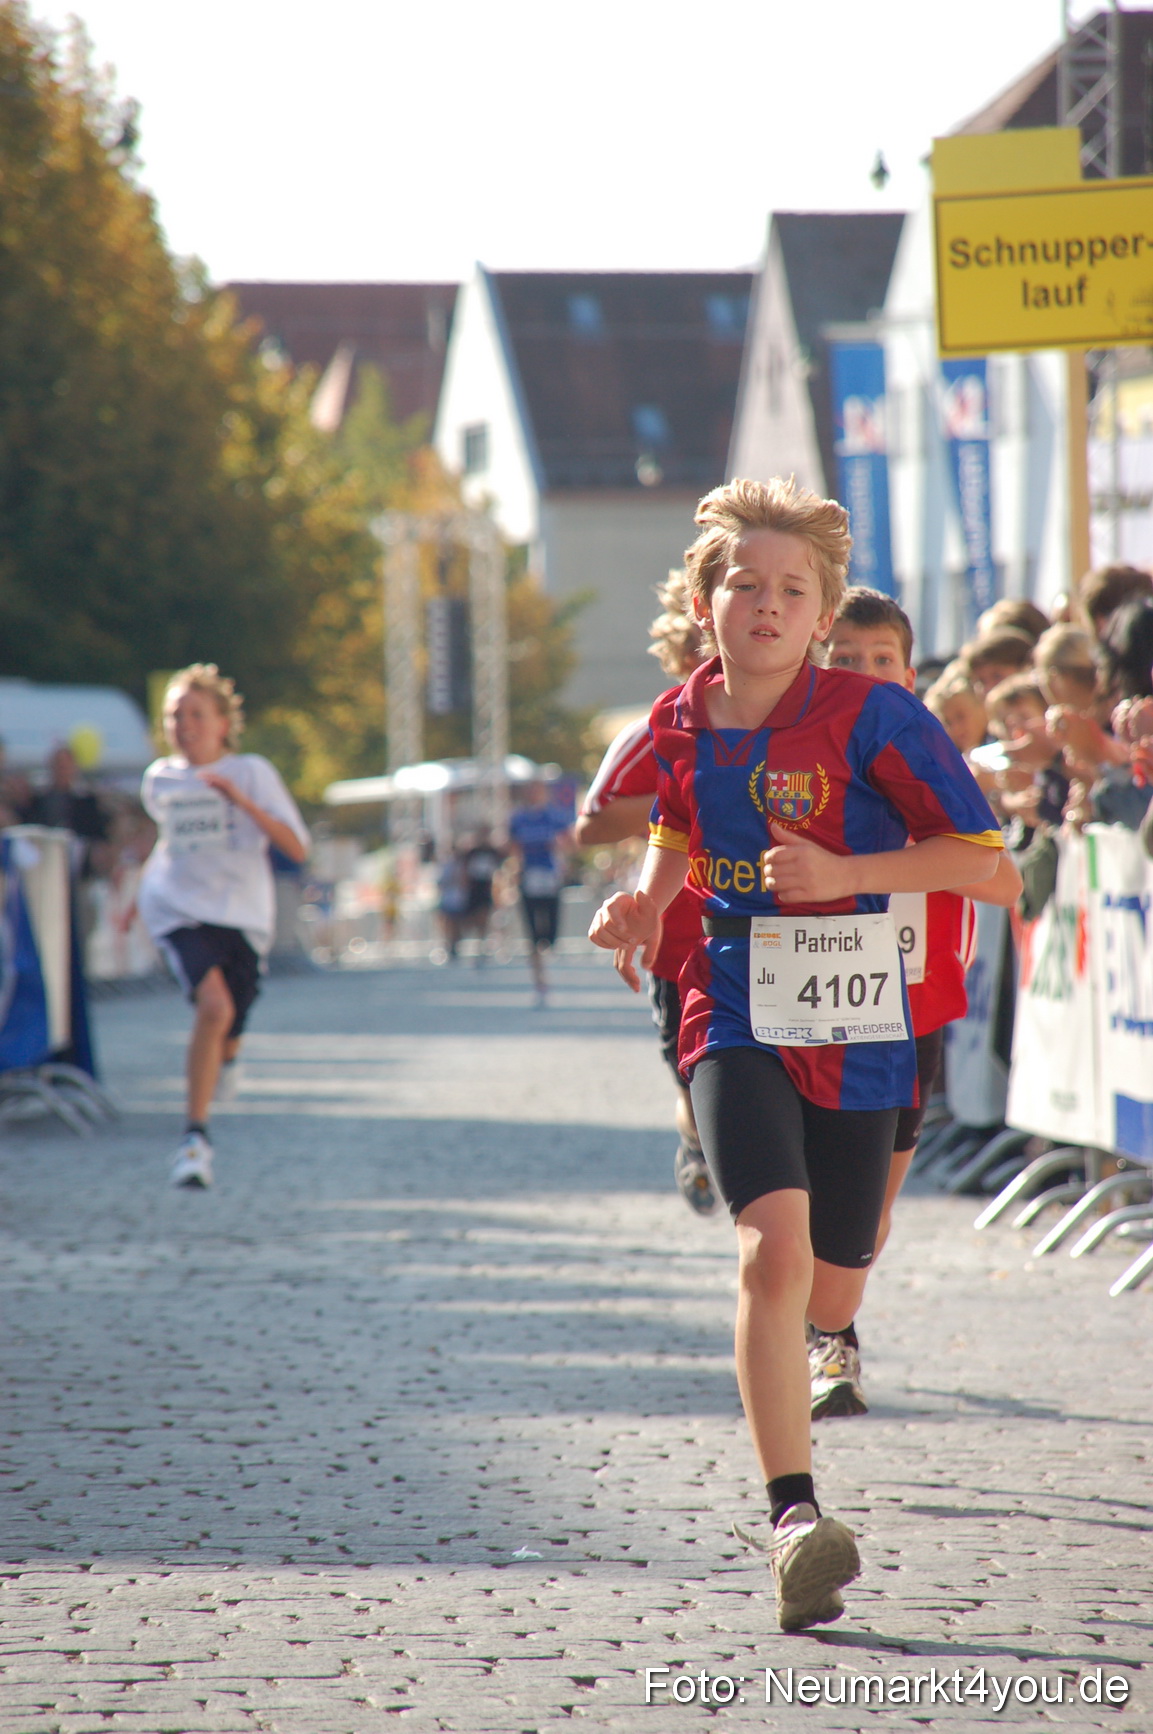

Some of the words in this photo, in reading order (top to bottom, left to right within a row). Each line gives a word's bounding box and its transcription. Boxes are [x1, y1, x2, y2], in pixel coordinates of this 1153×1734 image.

[1022, 274, 1088, 310] lauf
[688, 849, 769, 893] nicef
[795, 928, 863, 953] Patrick
[757, 967, 775, 985] Ju
[797, 972, 889, 1009] 4107
[847, 1022, 904, 1035] PFLEIDERER
